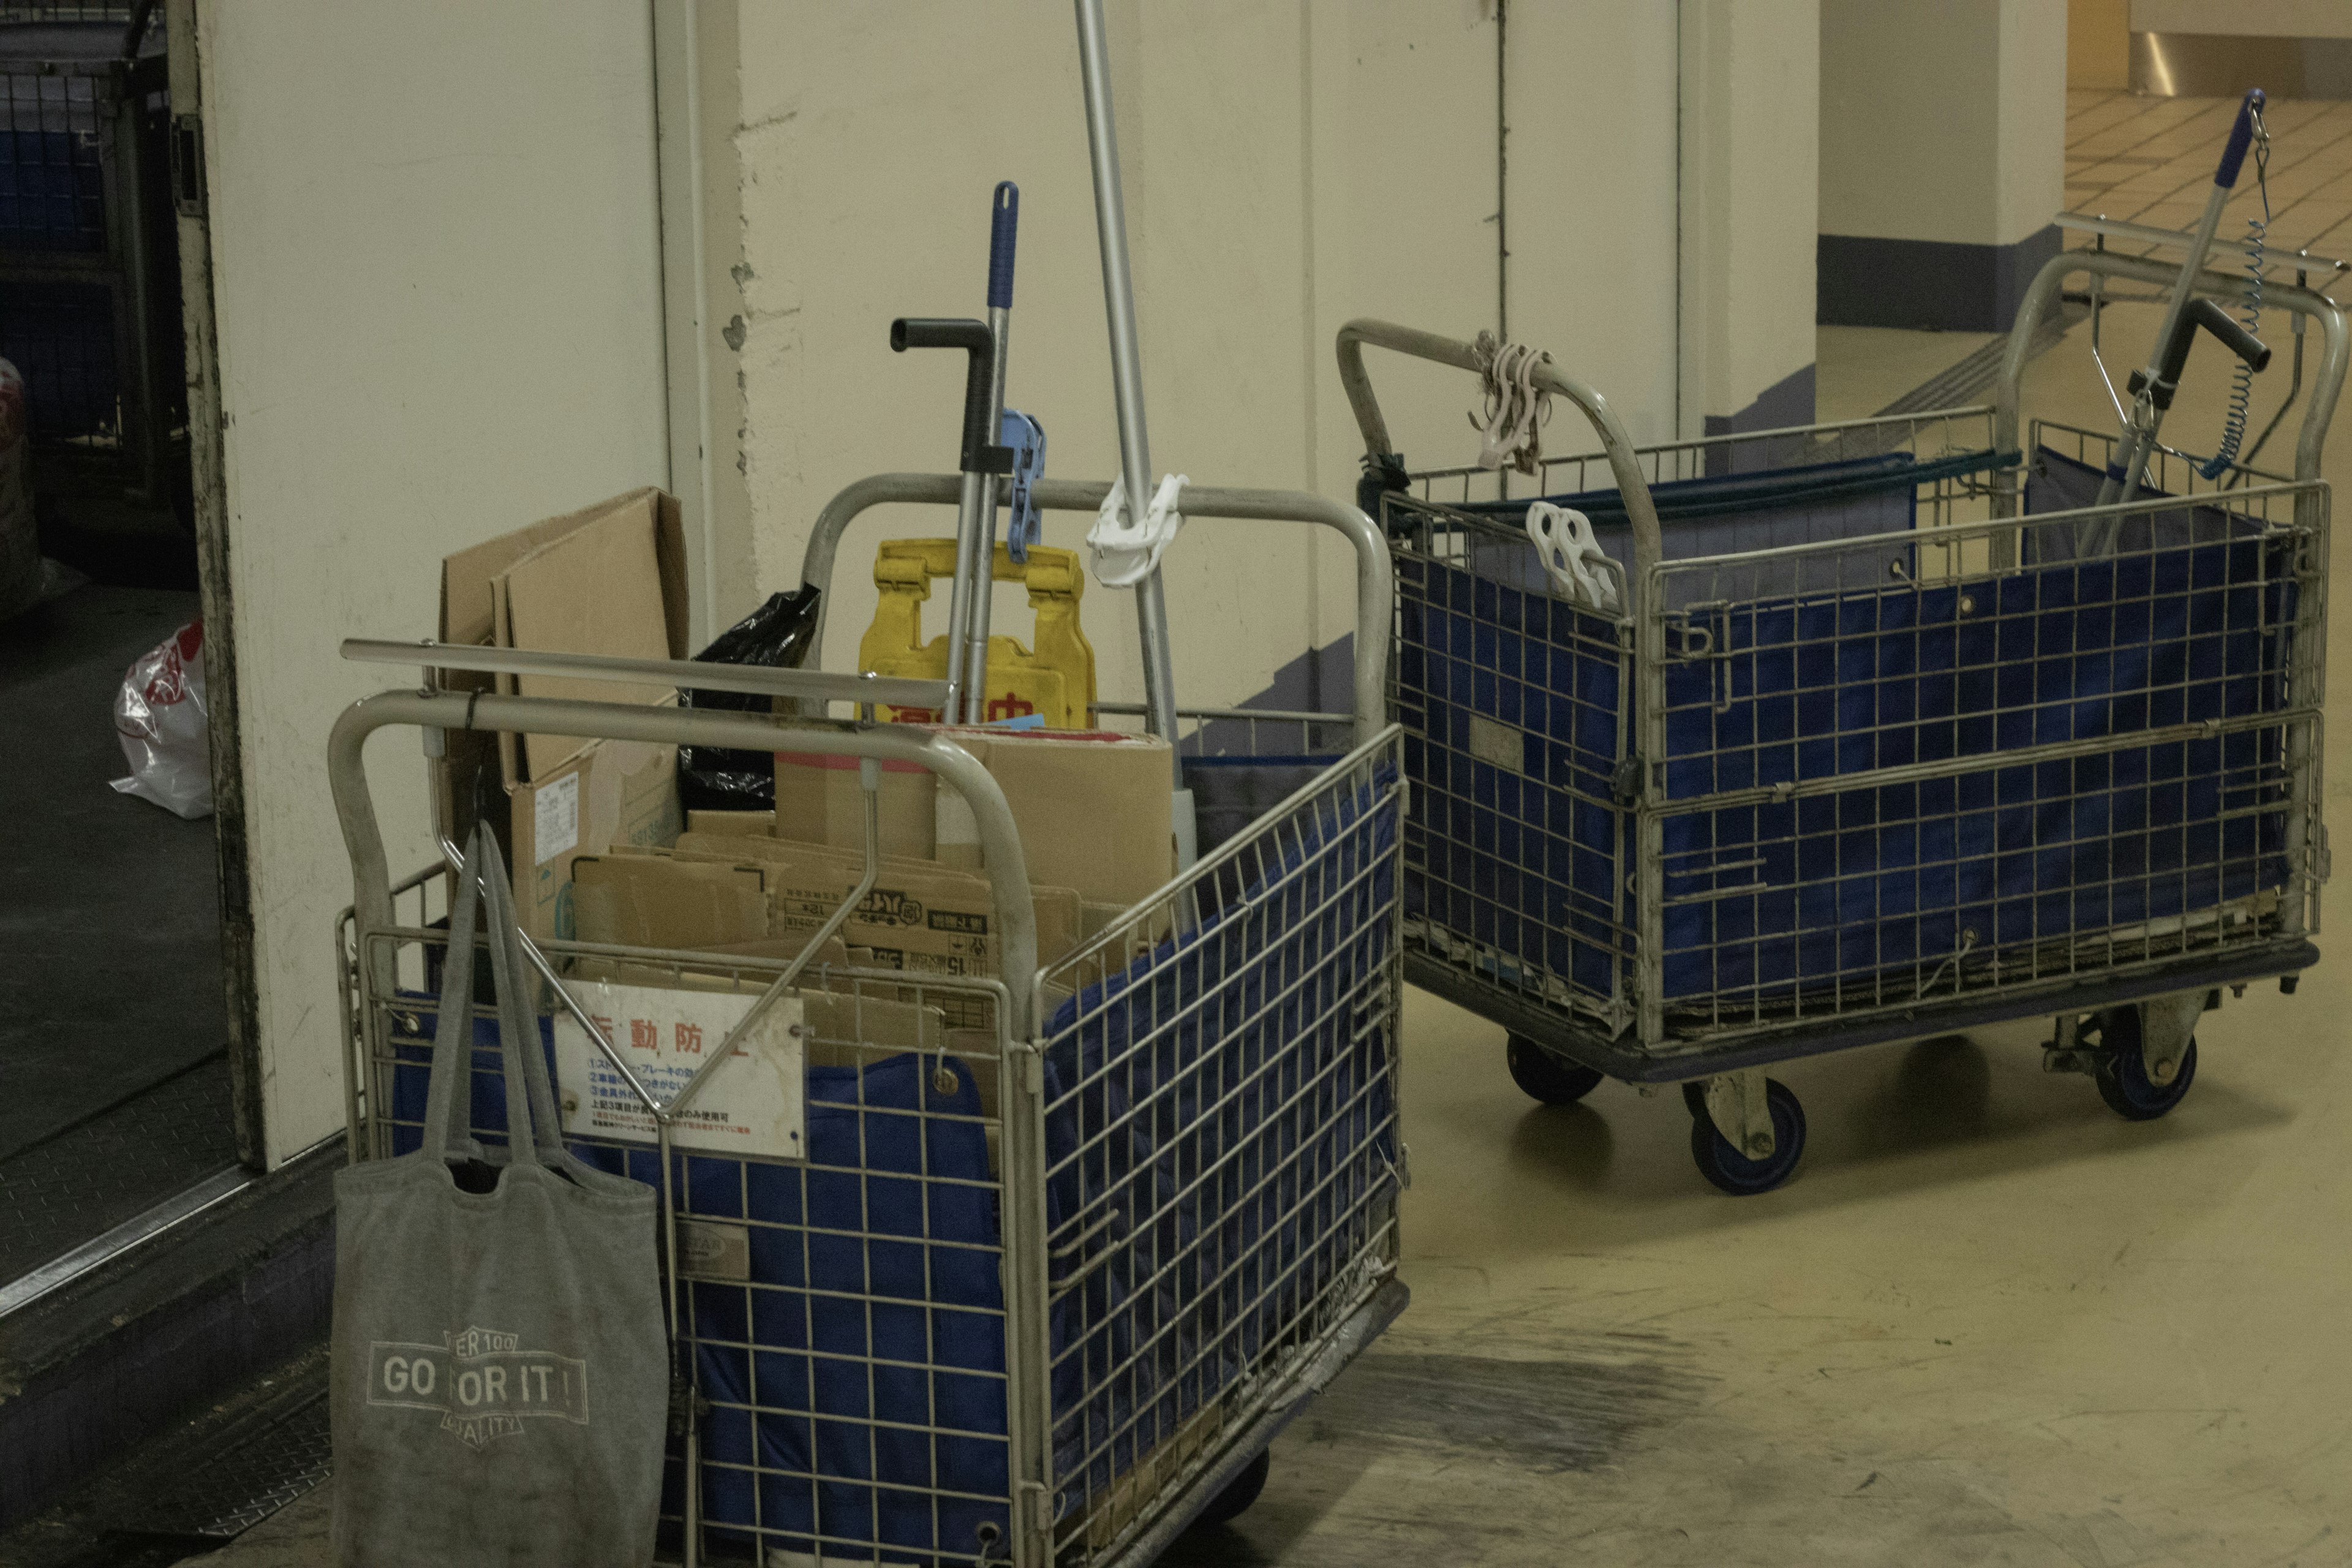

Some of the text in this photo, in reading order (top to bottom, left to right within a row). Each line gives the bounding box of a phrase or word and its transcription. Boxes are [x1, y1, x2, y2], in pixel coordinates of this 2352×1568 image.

[947, 957, 967, 976] 15
[483, 1333, 513, 1351] 100
[383, 1356, 435, 1395] GO
